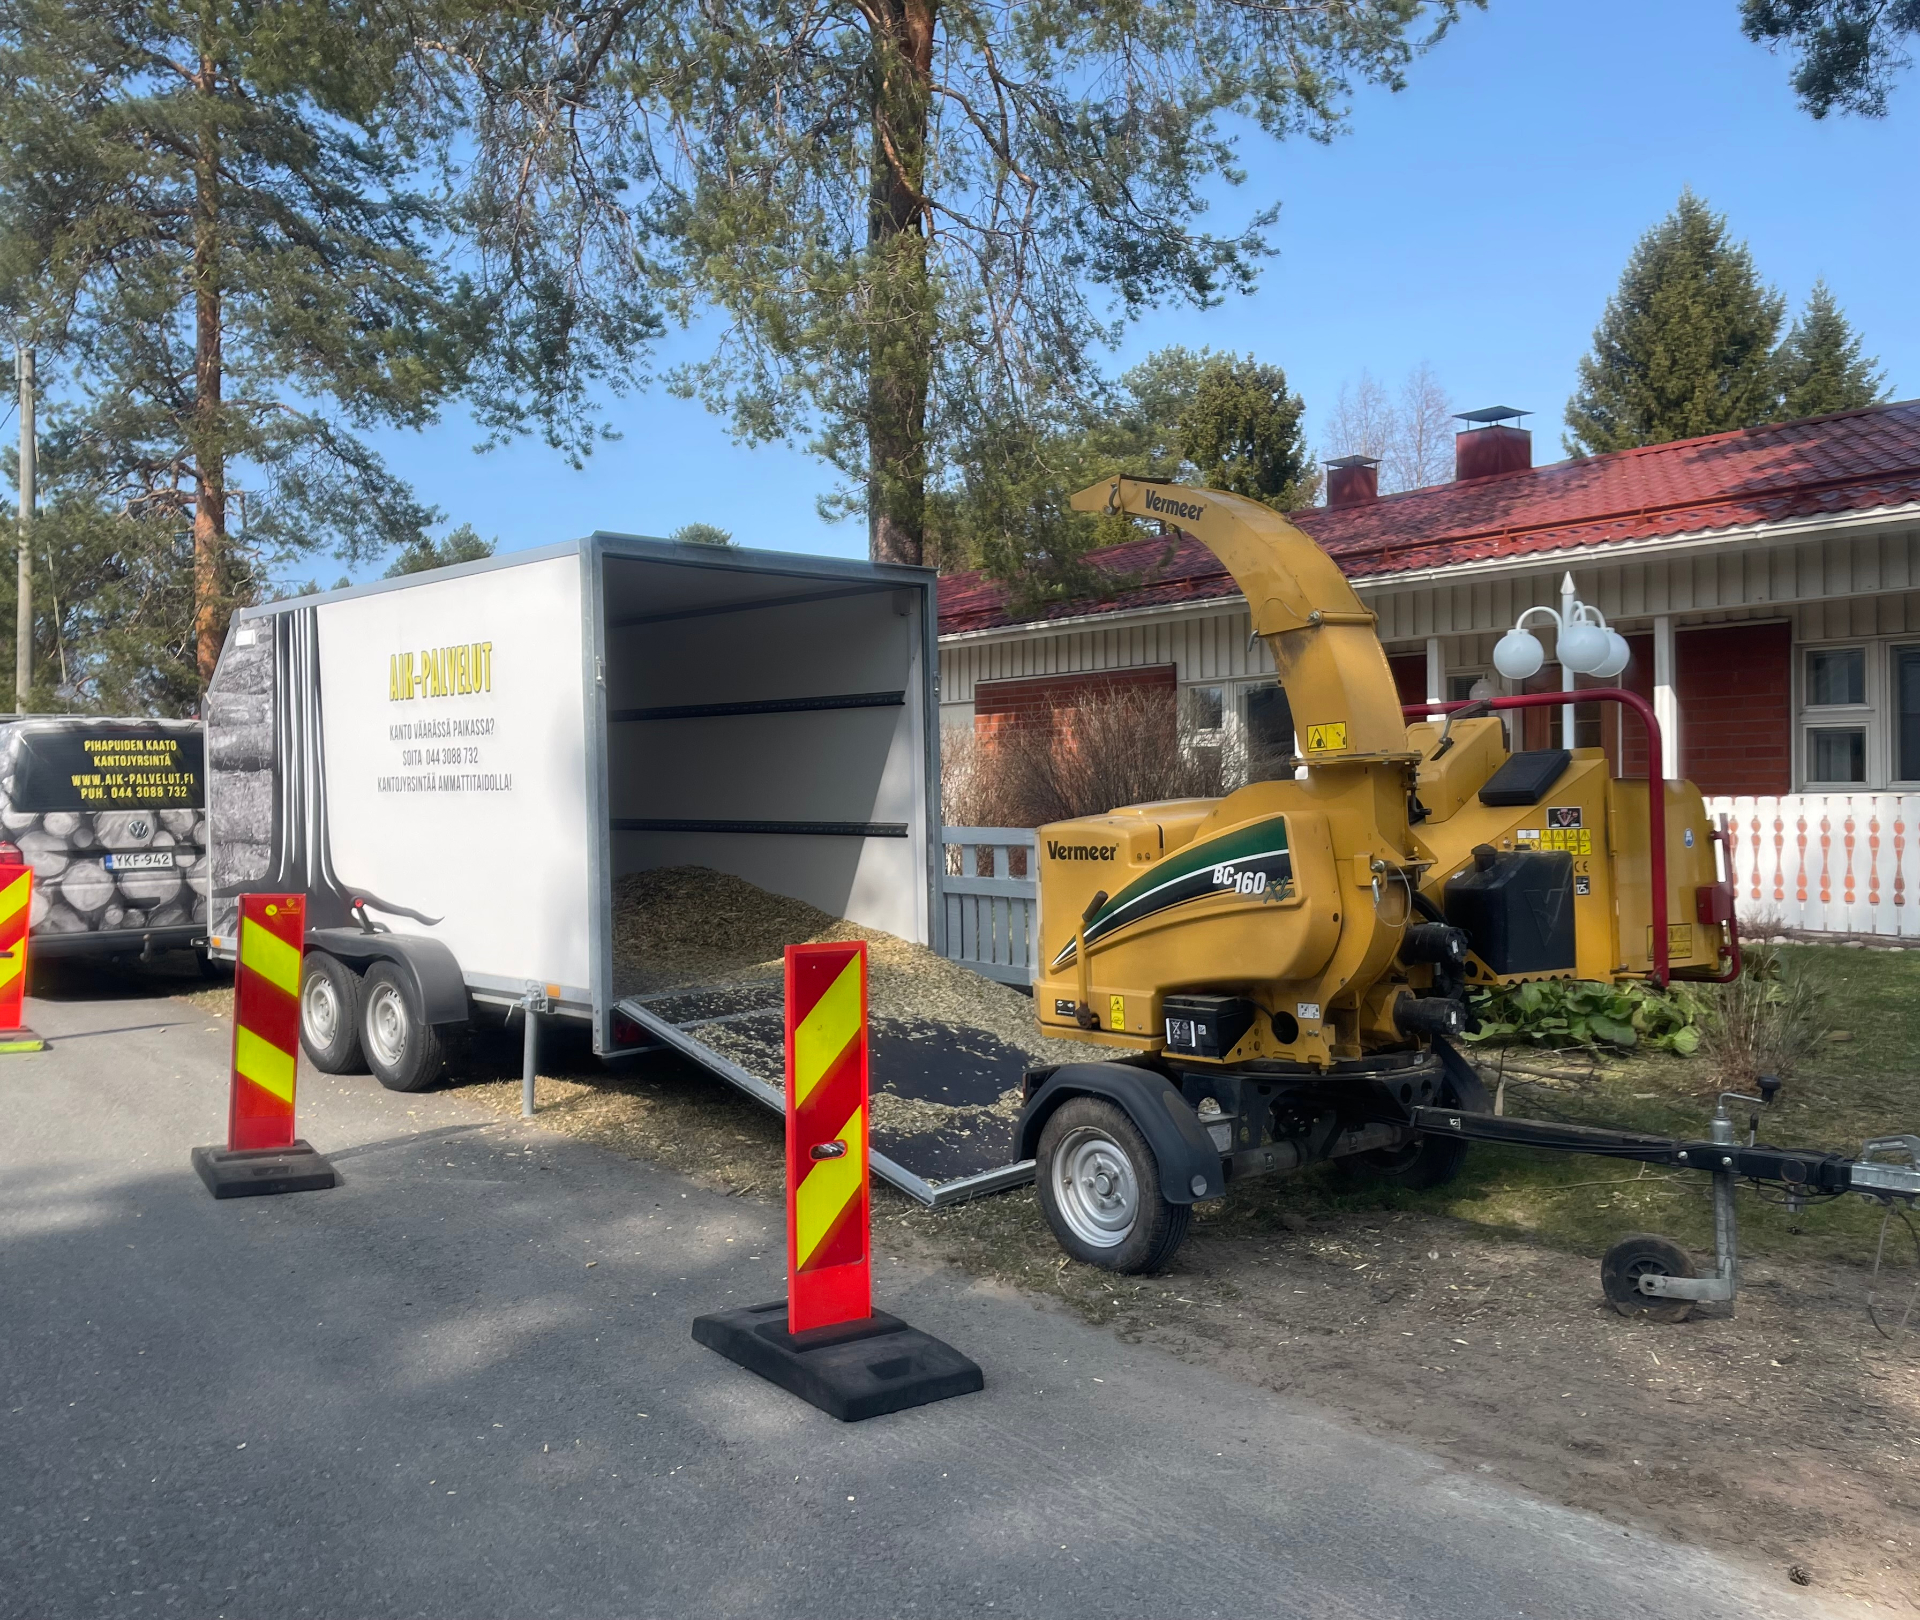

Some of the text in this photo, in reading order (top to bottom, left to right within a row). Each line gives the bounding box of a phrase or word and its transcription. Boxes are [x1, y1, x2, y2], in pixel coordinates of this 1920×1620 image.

[1145, 489, 1204, 521] Vermeer
[389, 641, 493, 702] AIK-PALVELUT
[389, 717, 495, 741] KANTO VÄÄRÄSSÄ PAIKASSA?
[84, 740, 177, 752] PIHAPUIDEN KAATO
[93, 752, 171, 767] KANTOJYRSINTÄ
[402, 746, 479, 766] SOITA 044 3088 732
[71, 773, 194, 786] WWW.AIK-PALVELUT.FI
[377, 772, 513, 792] KANTOJYRSINTÄÄ AMMATTITAIDOLLA!
[81, 785, 187, 800] PUH. 044 3088 732
[1046, 840, 1117, 861] Vermeer
[115, 853, 170, 867] YKF-942
[1574, 860, 1589, 873] CE
